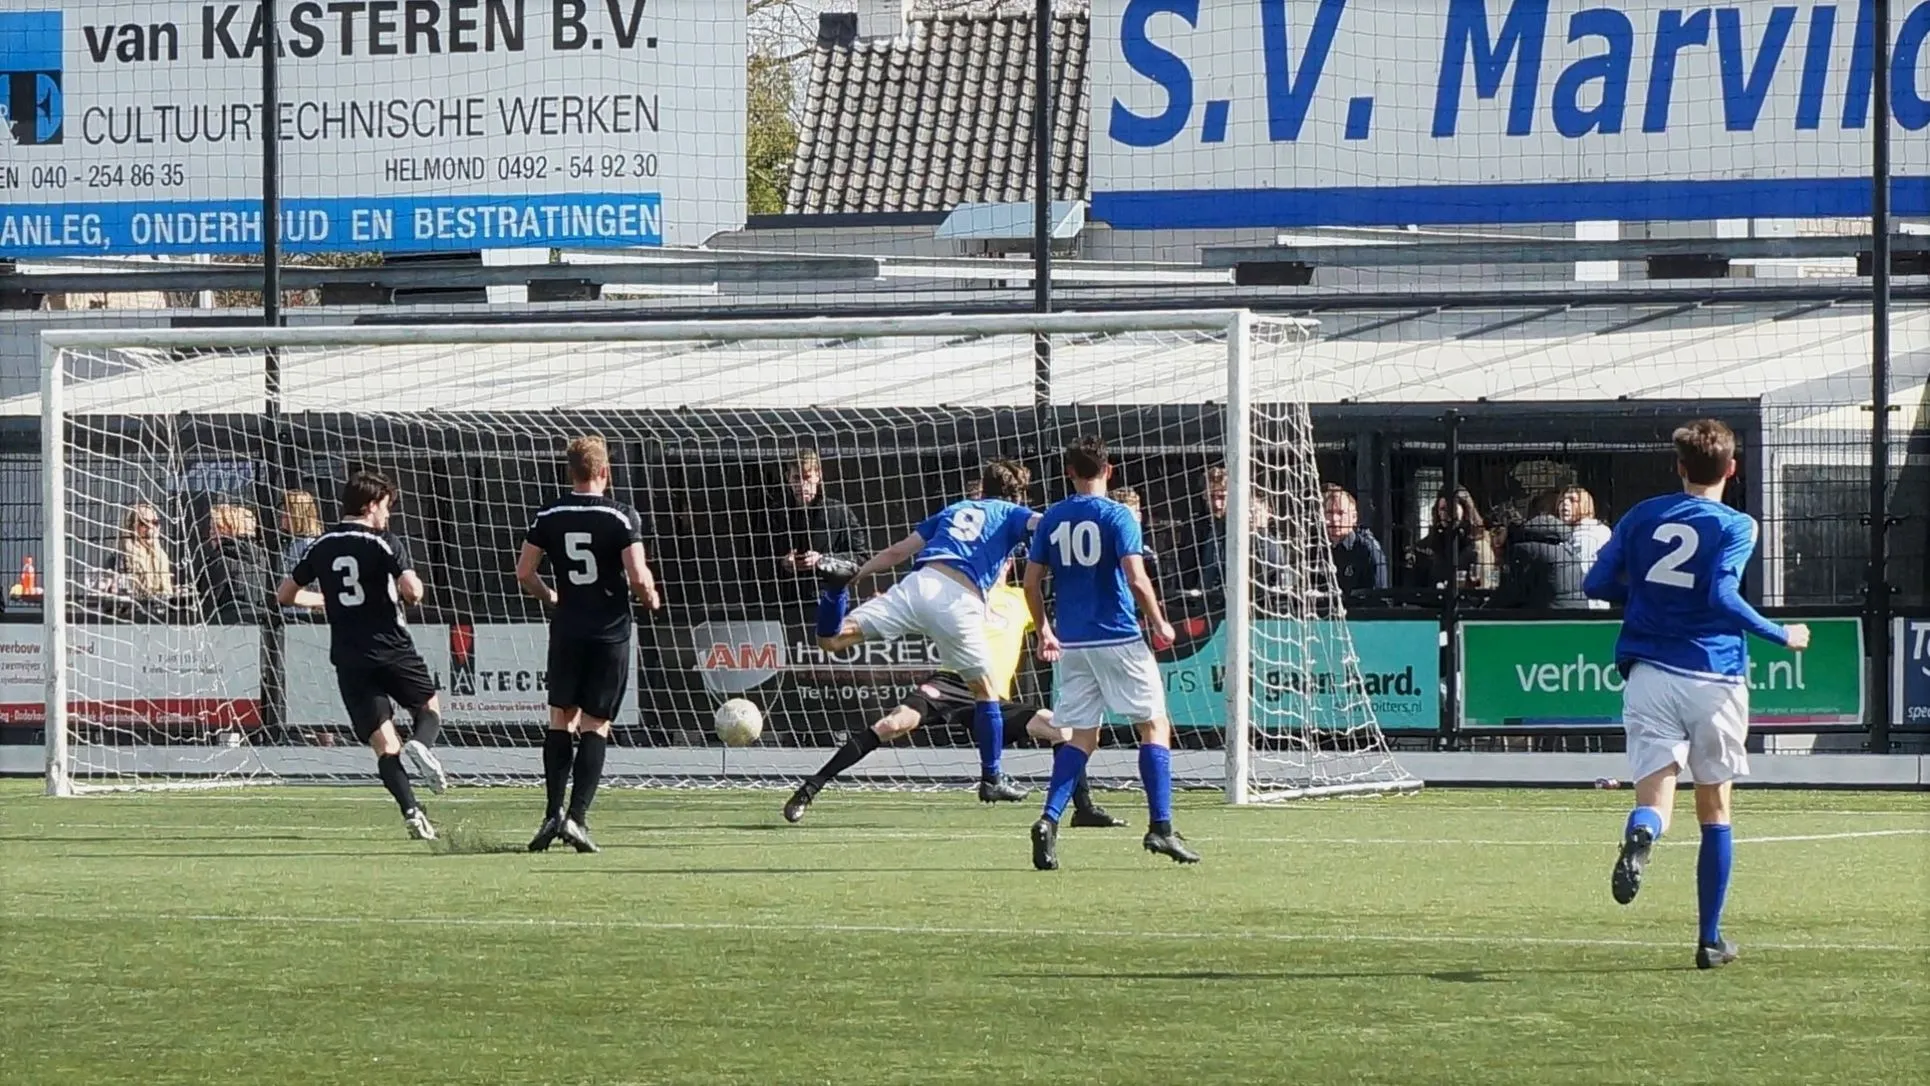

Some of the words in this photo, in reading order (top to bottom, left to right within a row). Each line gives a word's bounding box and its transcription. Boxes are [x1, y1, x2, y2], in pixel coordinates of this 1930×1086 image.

[84, 22, 178, 62] van
[202, 0, 525, 59] KASTEREN
[552, 0, 658, 50] B.V.
[1109, 0, 1374, 147] S.V.
[499, 95, 659, 135] WERKEN
[32, 166, 67, 189] 040
[88, 165, 123, 188] 254
[130, 164, 154, 186] 86
[161, 164, 184, 186] 35
[385, 157, 484, 182] HELMOND
[498, 156, 547, 180] 0492
[569, 156, 594, 179] 54
[601, 156, 625, 178] 92
[633, 154, 657, 177] 30
[352, 208, 392, 241] EN
[414, 203, 661, 240] BESTRATINGEN
[949, 507, 986, 542] 9
[1050, 520, 1102, 567] 10
[564, 532, 599, 585] 5
[1645, 523, 1700, 589] 2
[332, 556, 366, 606] 3
[705, 642, 780, 670] AM
[801, 686, 834, 700] Tel.
[1346, 665, 1422, 696] hard.
